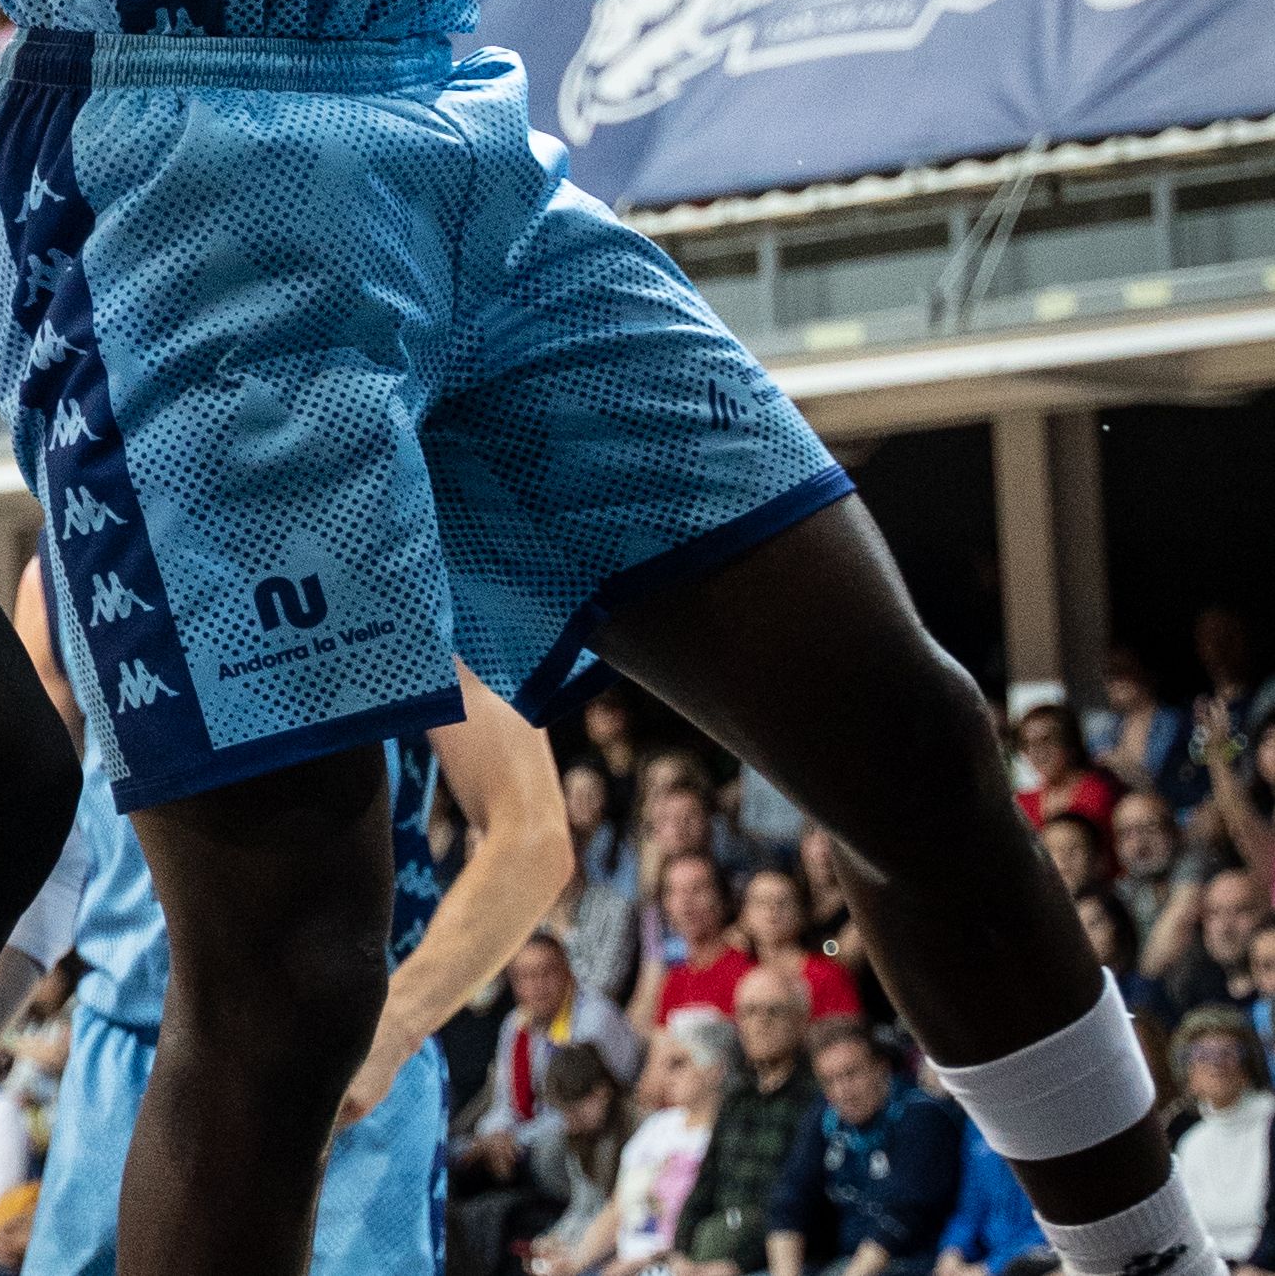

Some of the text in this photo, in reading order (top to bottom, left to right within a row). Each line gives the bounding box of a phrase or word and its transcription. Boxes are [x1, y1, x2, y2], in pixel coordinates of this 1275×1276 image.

[219, 619, 396, 681] Andorra la Vella
